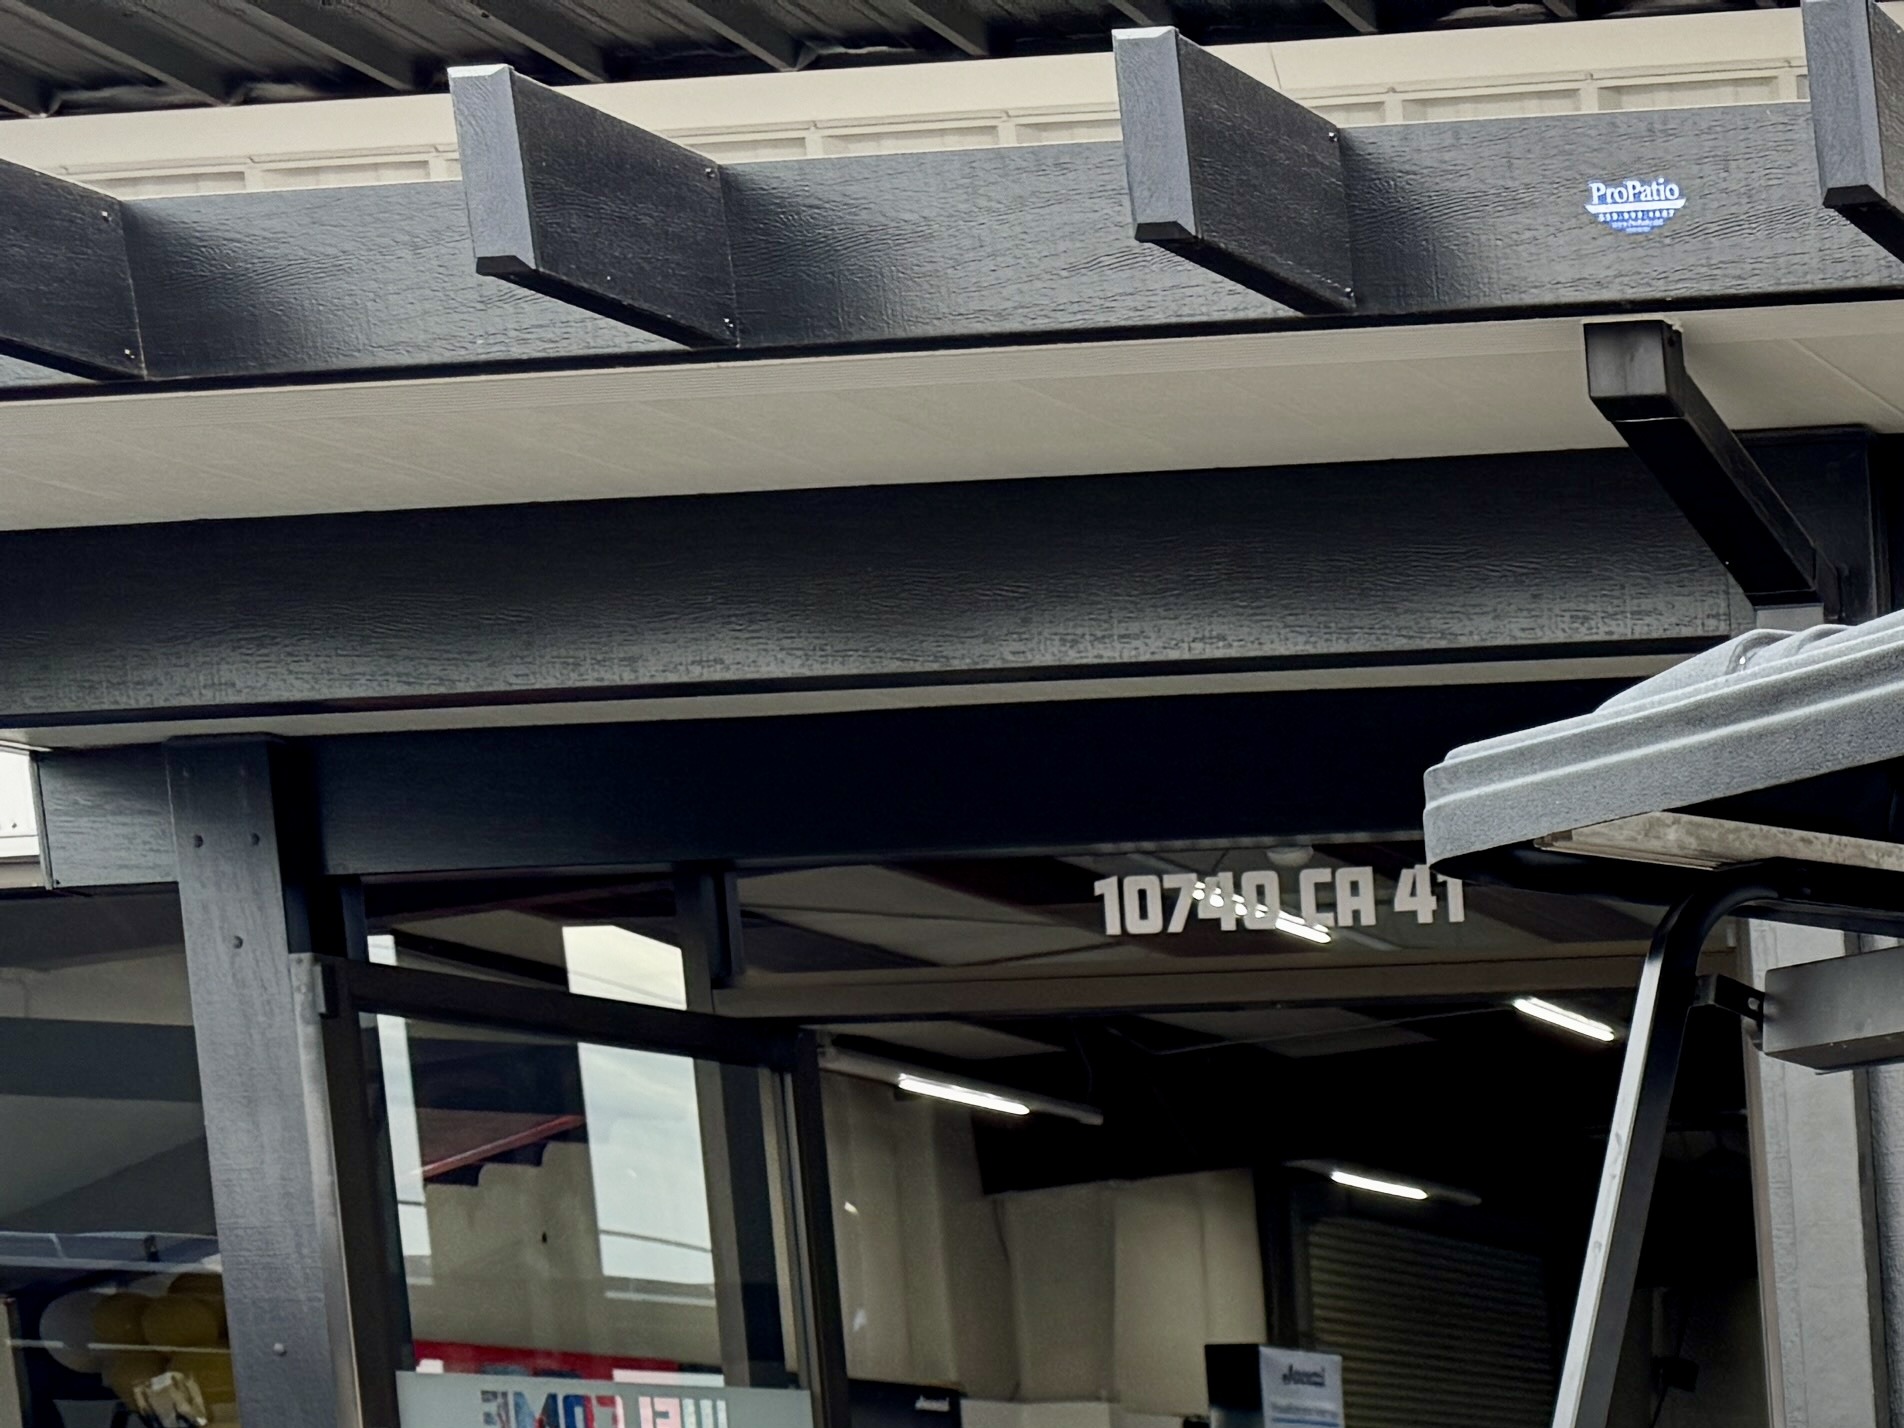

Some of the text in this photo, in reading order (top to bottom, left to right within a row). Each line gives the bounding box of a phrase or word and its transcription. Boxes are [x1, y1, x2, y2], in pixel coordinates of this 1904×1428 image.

[1587, 177, 1680, 205] ProPatio
[1094, 864, 1465, 936] 10740 CA 41
